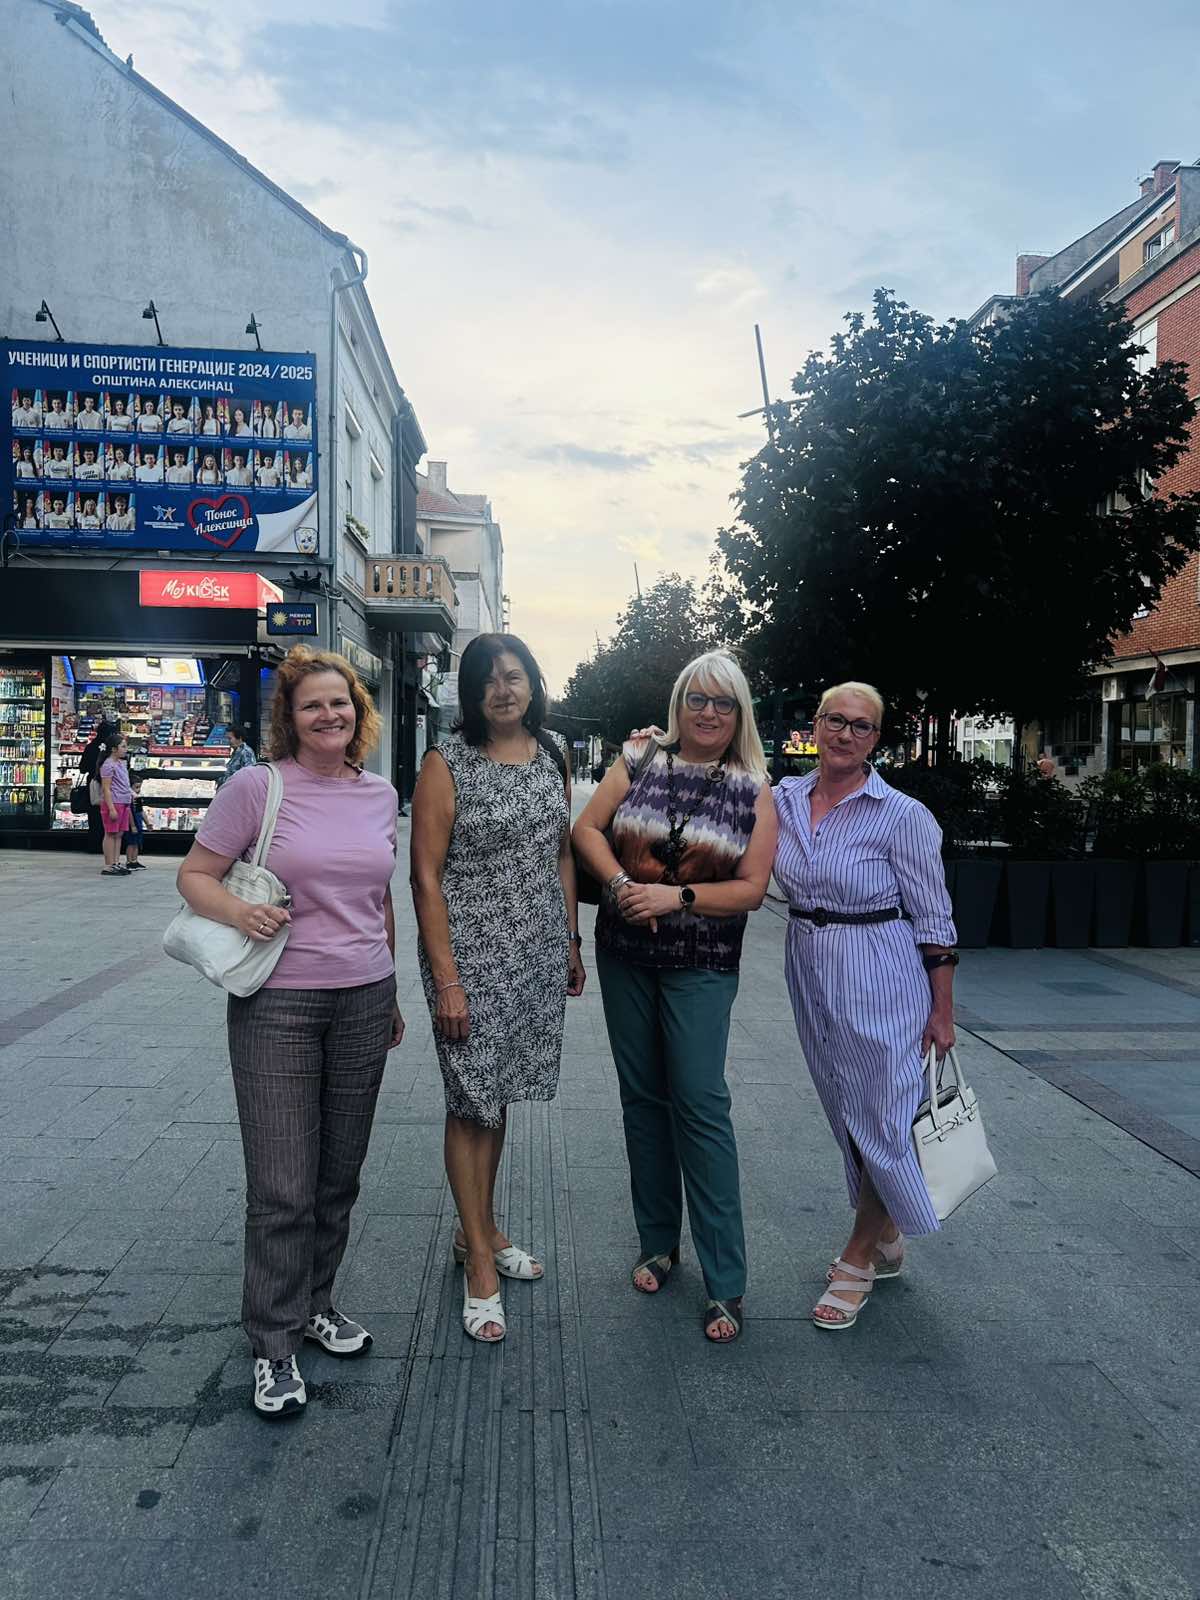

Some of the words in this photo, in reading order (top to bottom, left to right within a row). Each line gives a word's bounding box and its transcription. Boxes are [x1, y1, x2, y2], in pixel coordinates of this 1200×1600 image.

[8, 351, 68, 369] УЧЕНИЦИ
[71, 353, 80, 368] И
[83, 354, 156, 372] СПОРТИСТИ
[159, 358, 236, 377] ГЕНЕРАЦИЈЕ
[238, 363, 313, 380] 2024/2025
[92, 374, 156, 388] ОПШТИНА
[159, 378, 234, 394] АЛЕКСИНАЦ
[204, 508, 238, 521] Понос
[194, 517, 254, 536] Алексинца
